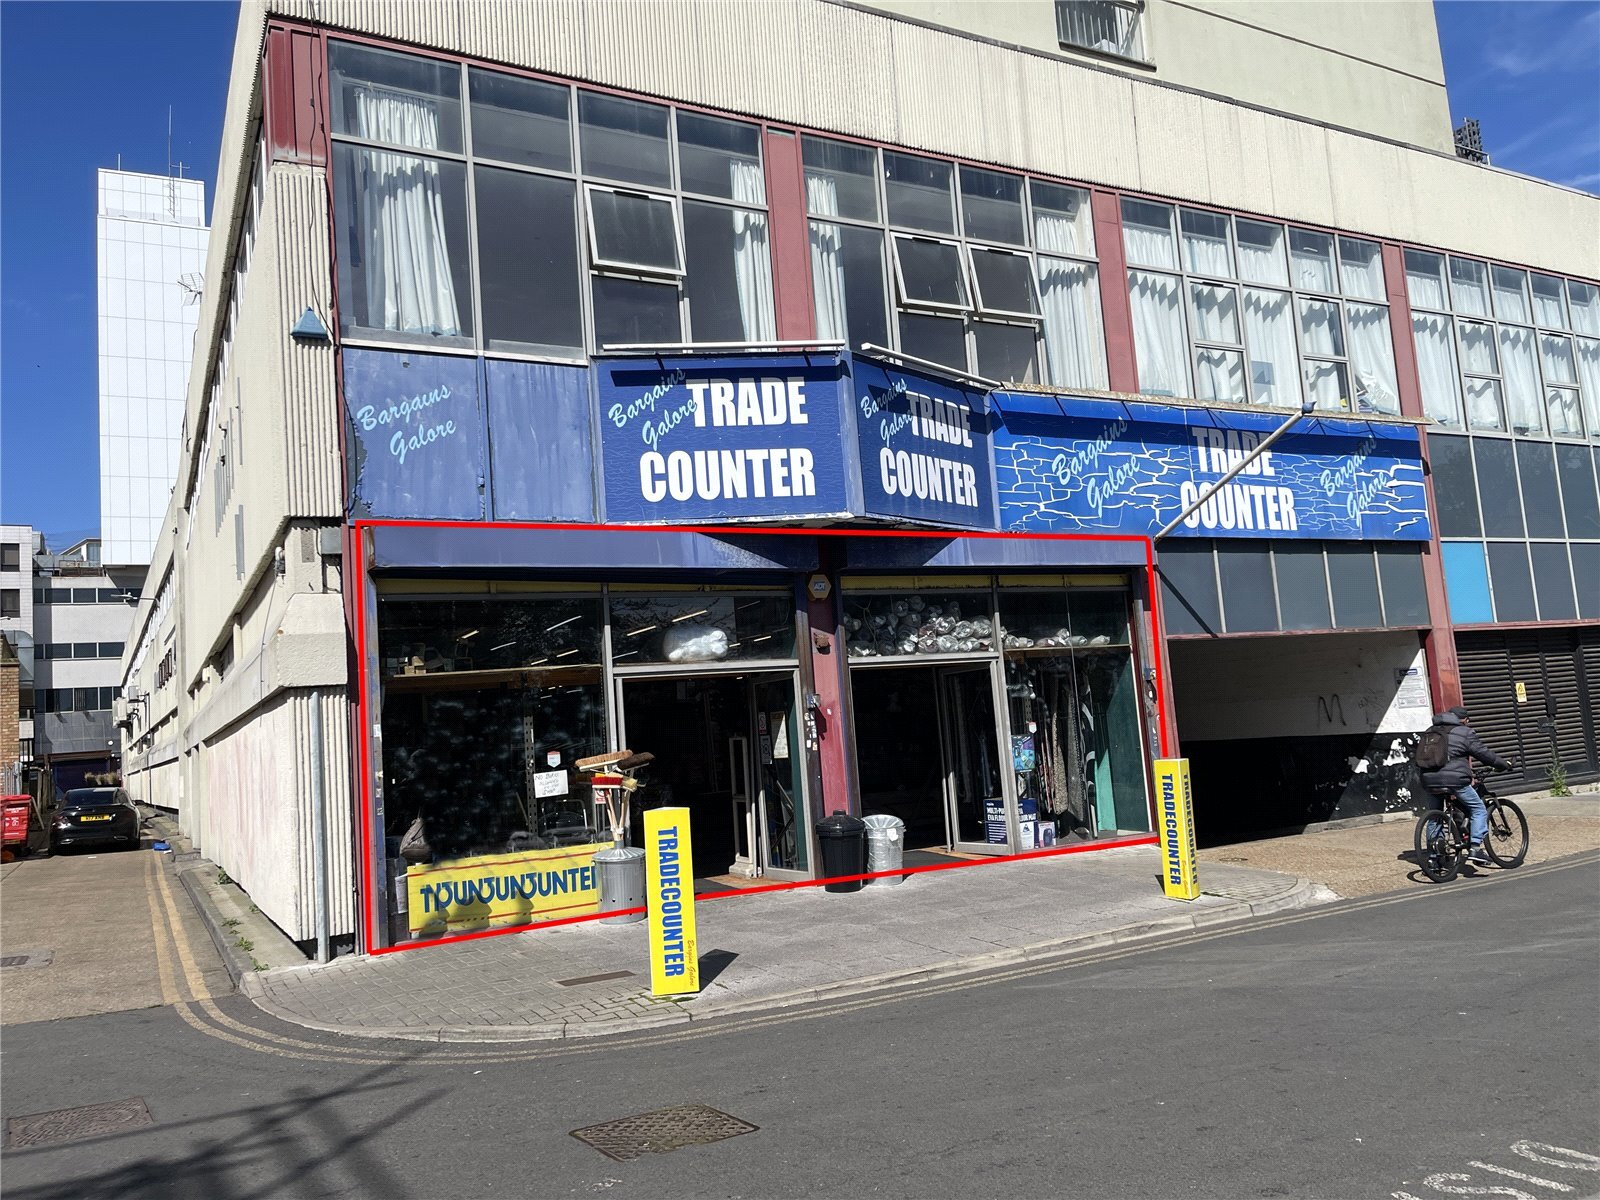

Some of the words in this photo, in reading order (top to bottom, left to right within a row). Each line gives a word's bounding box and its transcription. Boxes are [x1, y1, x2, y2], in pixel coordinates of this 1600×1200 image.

[357, 384, 451, 431] Bargains
[608, 367, 686, 428] Bargains
[642, 399, 698, 452] Galore
[686, 376, 809, 428] TRADE
[860, 378, 908, 419] Bargains
[905, 390, 973, 448] TRADE
[389, 418, 457, 465] Galore
[1051, 415, 1128, 486] Bargains
[1191, 427, 1276, 477] TRADE
[1320, 434, 1377, 497] Bargains
[639, 447, 817, 502] COUNTER
[880, 447, 979, 508] COUNTER
[1086, 454, 1141, 519] Galore
[1346, 472, 1388, 528] Galore
[1180, 481, 1298, 531] COUNTER
[813, 582, 826, 591] ADT
[1162, 773, 1182, 886] TRADECOUNTER
[1183, 774, 1198, 885] TRADECOUNTER
[658, 825, 685, 977] TRADECOUNTER
